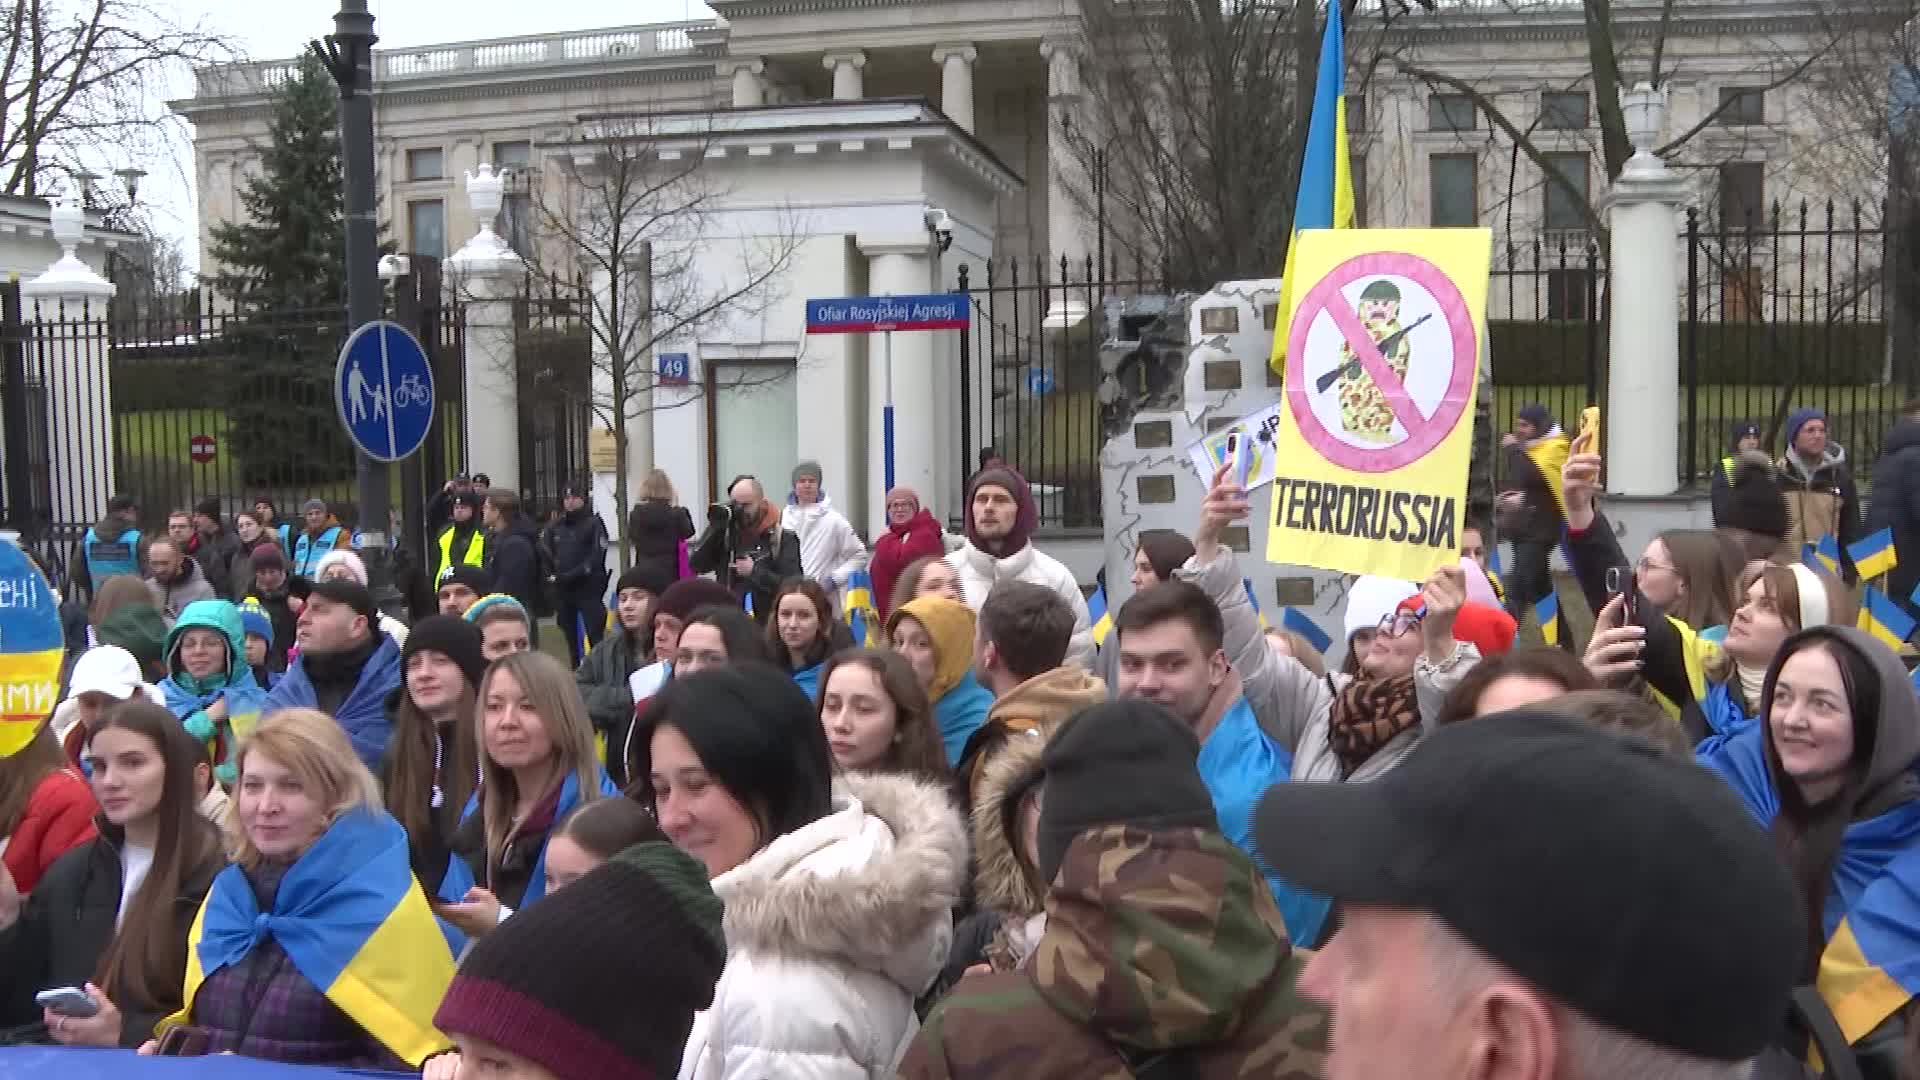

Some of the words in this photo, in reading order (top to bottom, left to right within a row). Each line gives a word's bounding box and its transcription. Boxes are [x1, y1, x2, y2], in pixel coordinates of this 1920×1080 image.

[818, 306, 847, 321] Ofiar
[850, 303, 909, 323] Rosyjskiej
[912, 302, 955, 321] Agresji
[662, 359, 683, 377] 49
[1275, 477, 1455, 549] TERRORUSSIA
